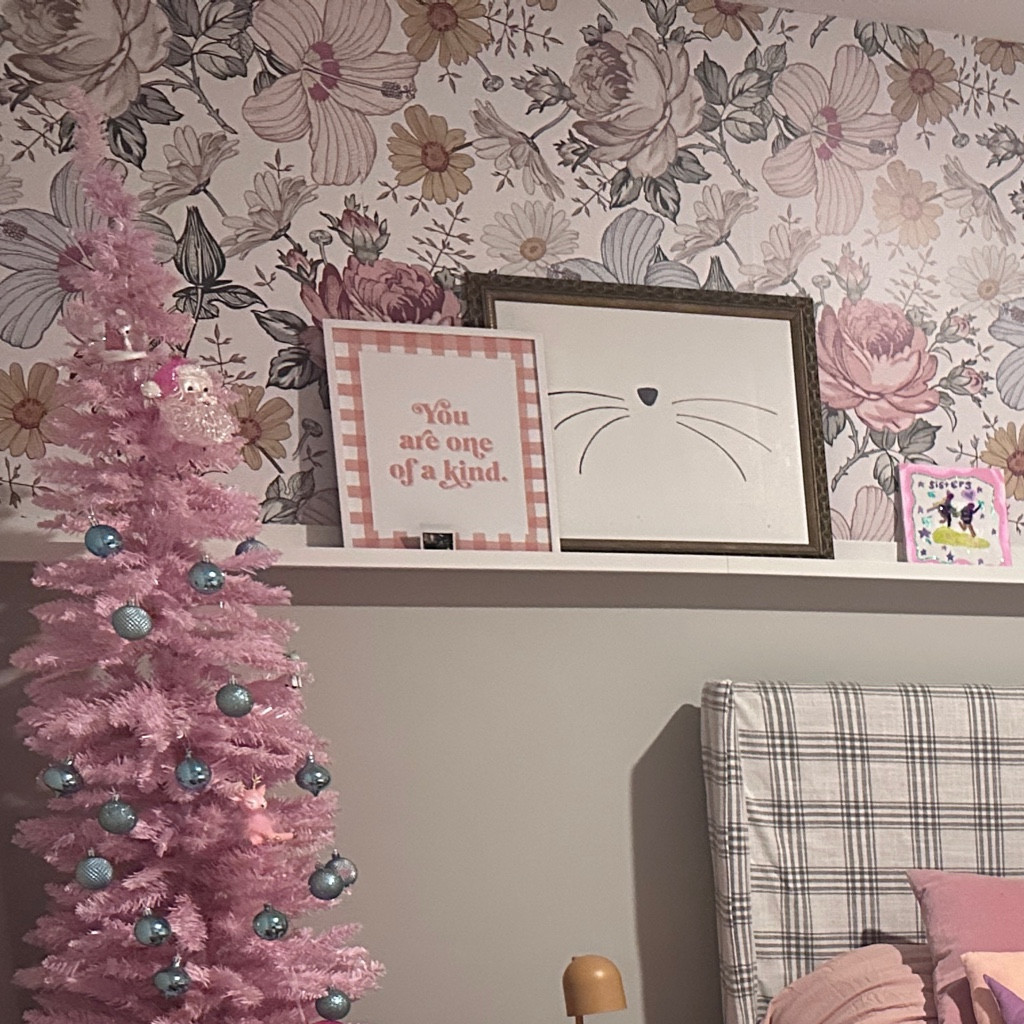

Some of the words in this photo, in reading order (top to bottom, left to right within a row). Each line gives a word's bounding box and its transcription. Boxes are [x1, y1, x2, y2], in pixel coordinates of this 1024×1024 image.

[412, 398, 470, 427] You
[399, 429, 440, 451] are
[446, 436, 494, 460] one
[389, 458, 419, 487] of
[421, 464, 437, 480] a
[438, 459, 509, 490] kind.
